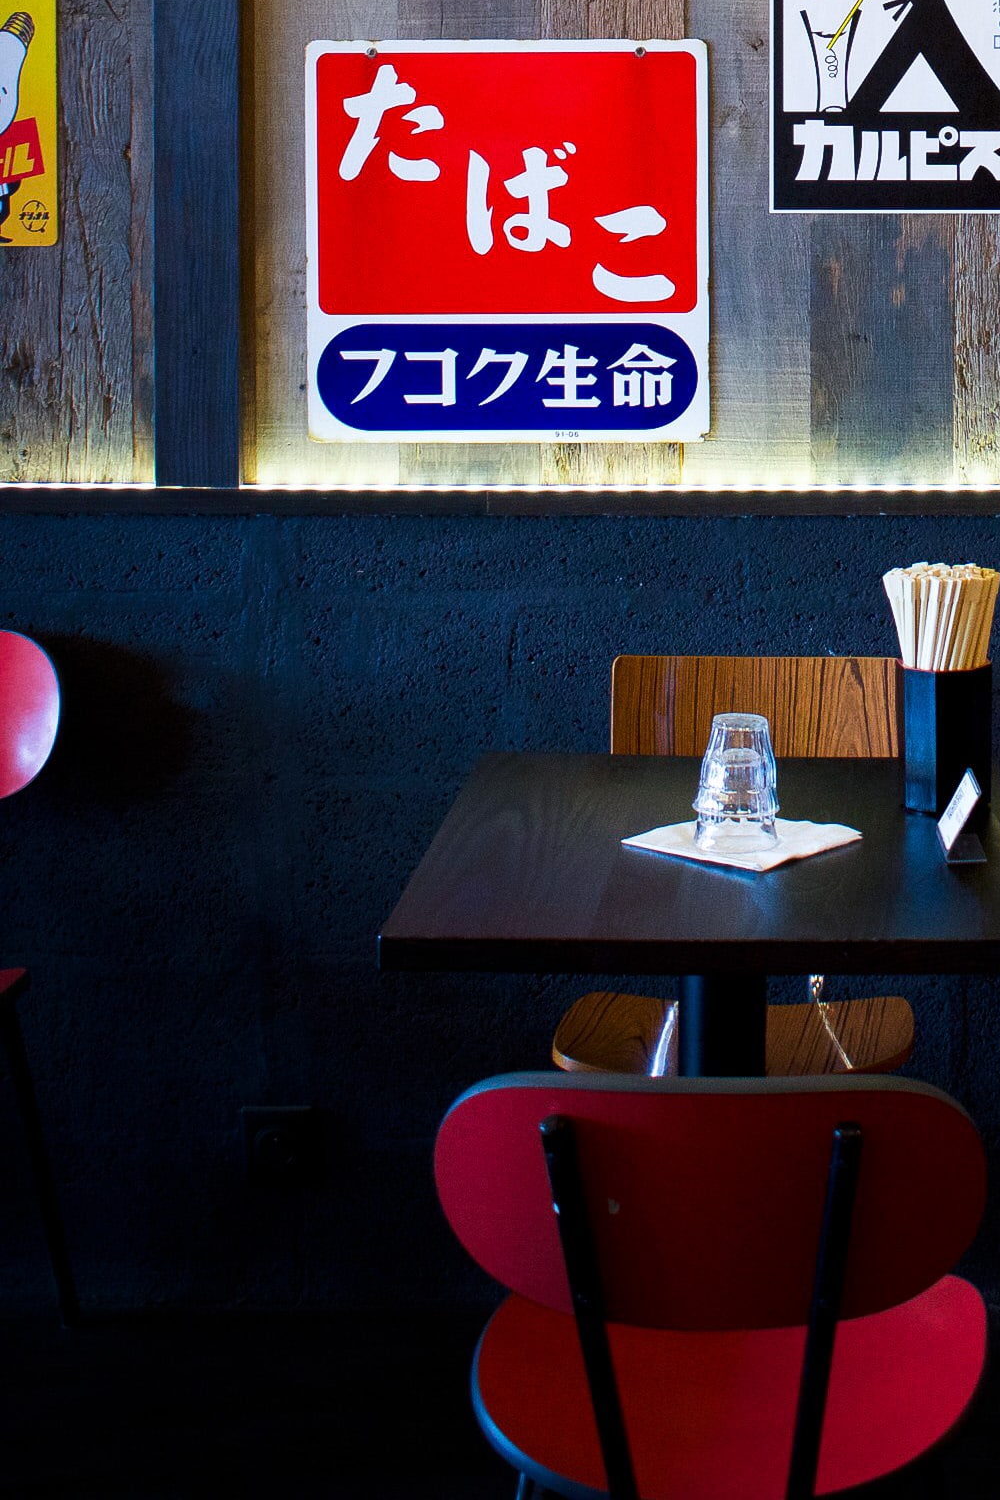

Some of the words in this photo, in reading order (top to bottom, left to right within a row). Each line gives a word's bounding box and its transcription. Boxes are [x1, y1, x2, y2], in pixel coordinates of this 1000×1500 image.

[338, 64, 676, 303] たばこ
[339, 342, 678, 409] フコク生命
